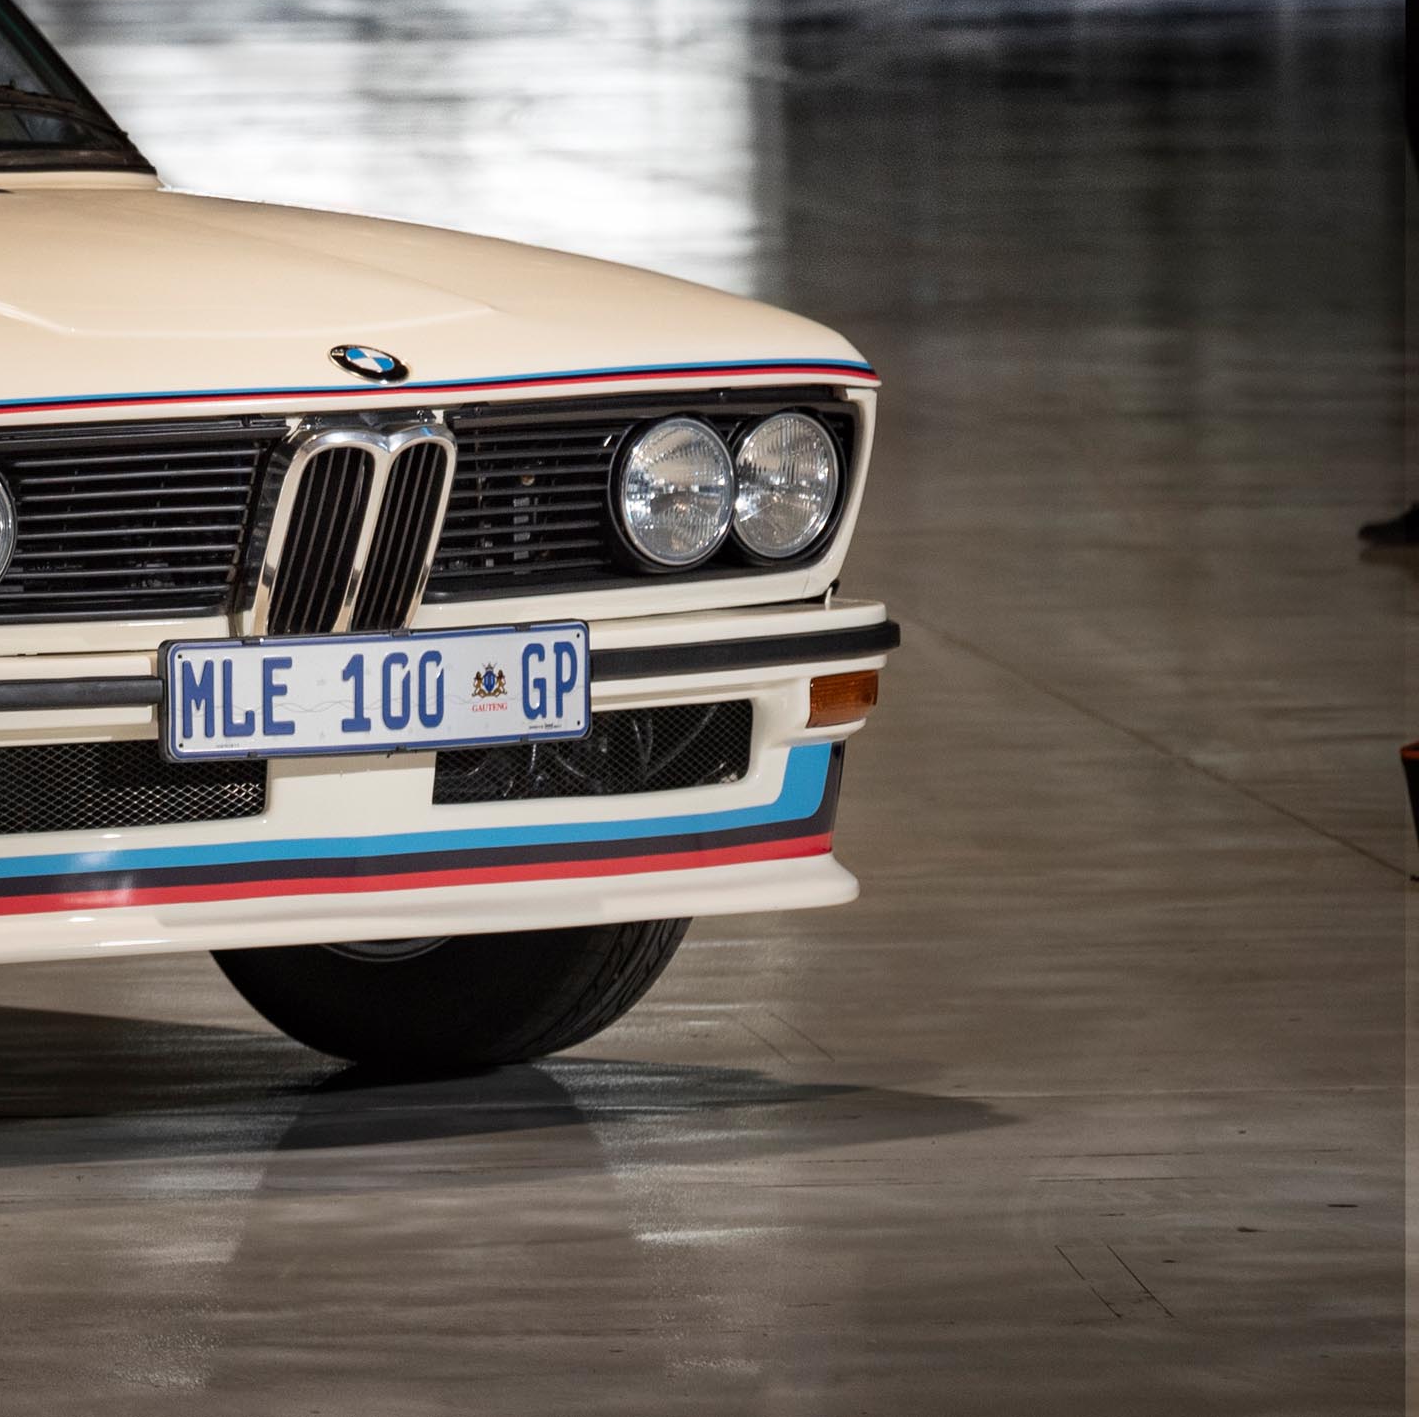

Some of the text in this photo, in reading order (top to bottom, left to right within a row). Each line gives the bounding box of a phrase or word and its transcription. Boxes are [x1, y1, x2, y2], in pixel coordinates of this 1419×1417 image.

[182, 640, 578, 739] MLE 100 GP
[471, 702, 508, 712] GAUTENG
